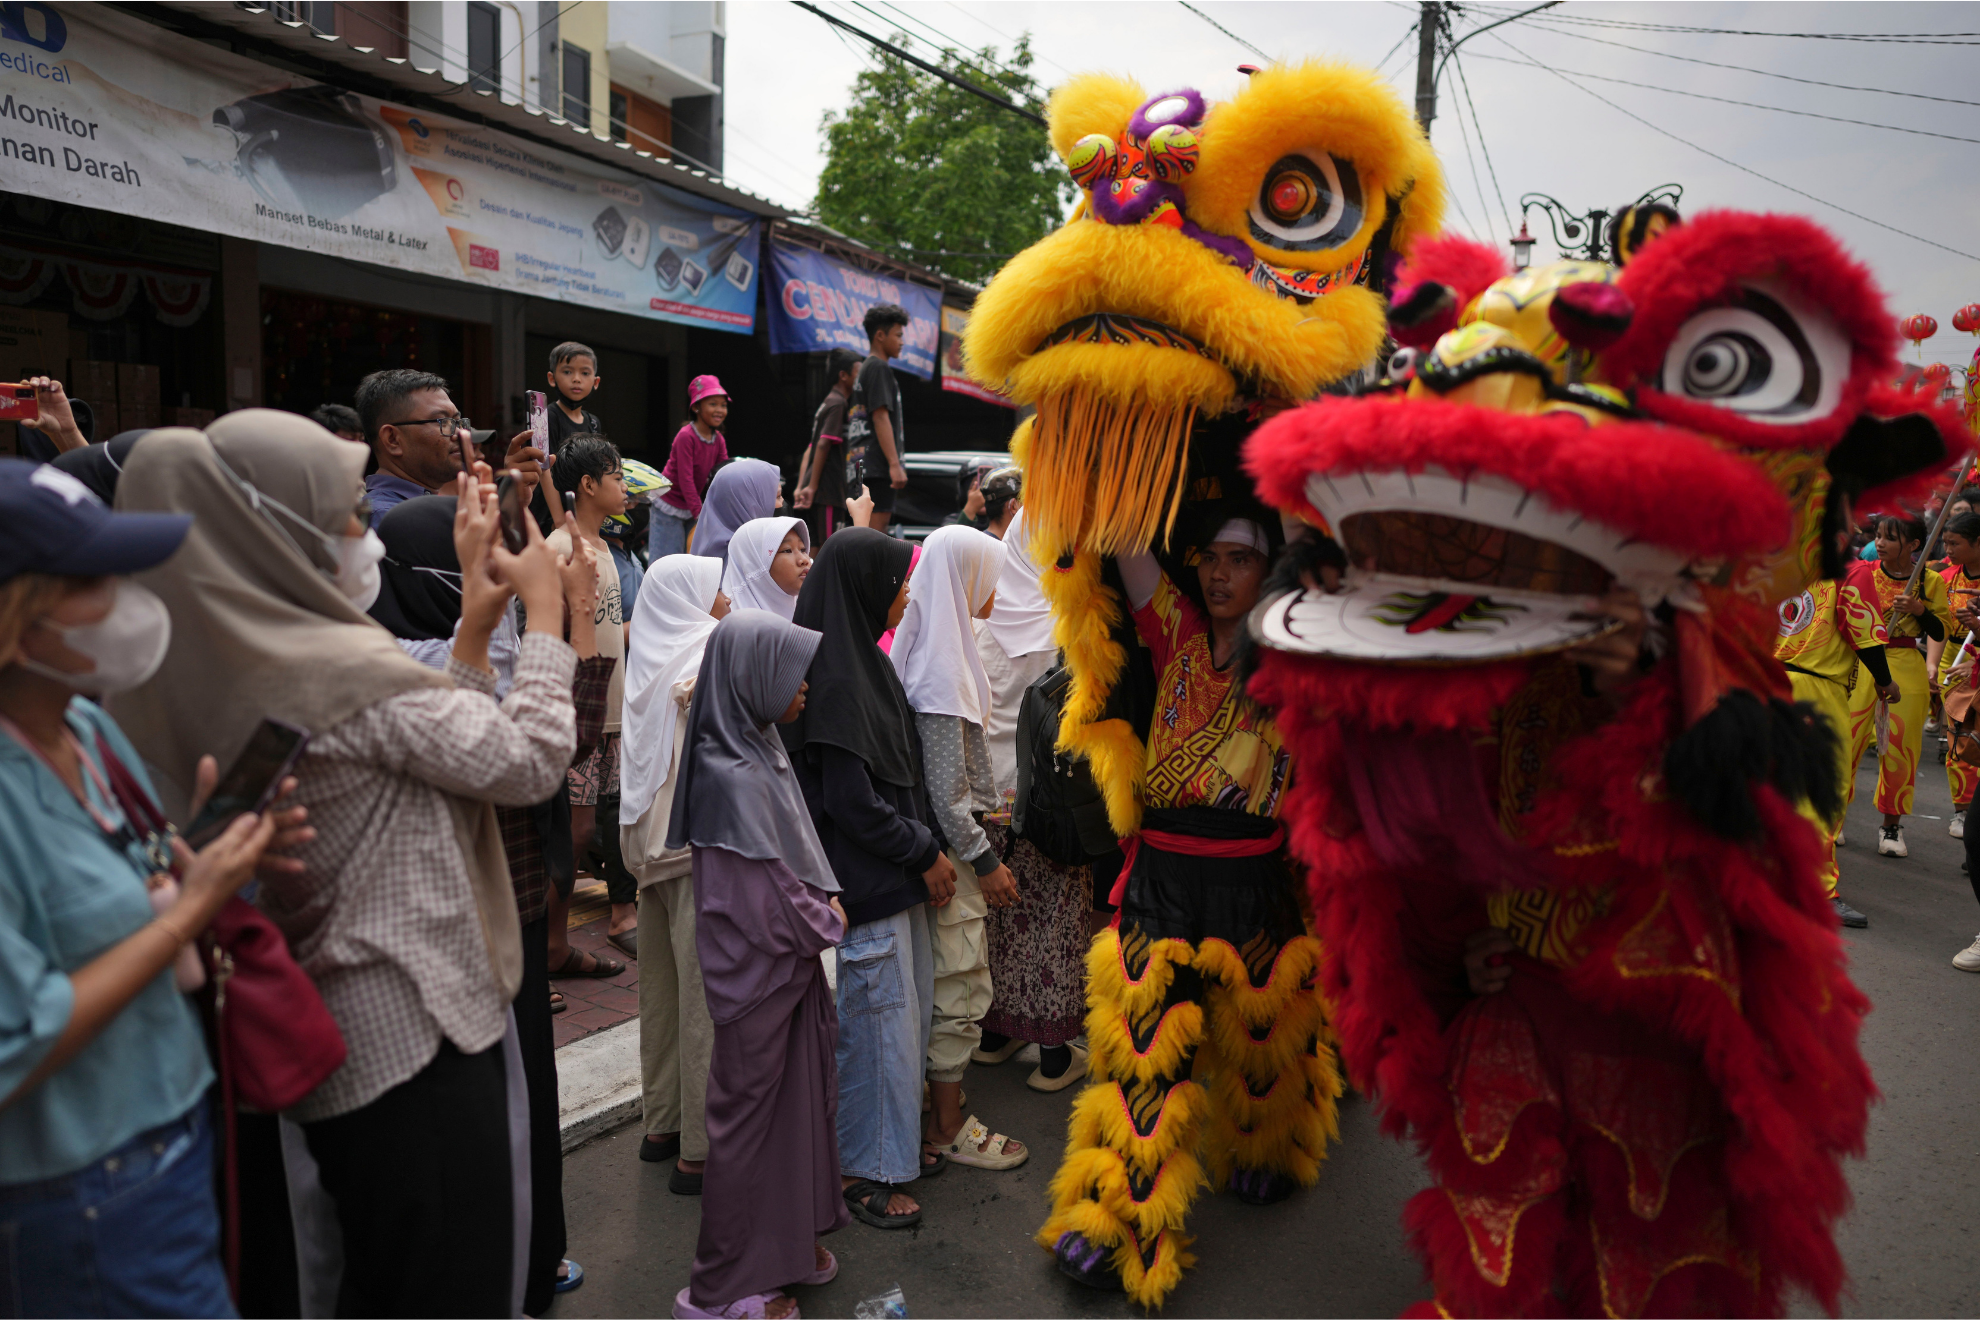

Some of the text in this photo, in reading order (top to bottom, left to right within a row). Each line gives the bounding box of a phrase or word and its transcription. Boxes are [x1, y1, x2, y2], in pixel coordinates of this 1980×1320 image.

[0, 137, 141, 187] nan Darah
[444, 145, 485, 164] Asosiasi
[485, 155, 527, 177] Hipertensi
[528, 170, 578, 192] Internasional
[445, 129, 491, 150] Tervalidasi
[492, 143, 522, 161] Secara
[522, 152, 545, 169] Klinis
[255, 203, 428, 250] Manset Bebas Metal & Latex
[480, 198, 508, 216] Desain
[509, 208, 525, 221] dan
[526, 212, 556, 229] Kualitas
[558, 221, 584, 239] Jepang
[541, 273, 571, 290] Jantung
[839, 268, 879, 299] TOKO
[901, 317, 939, 354] ARU
